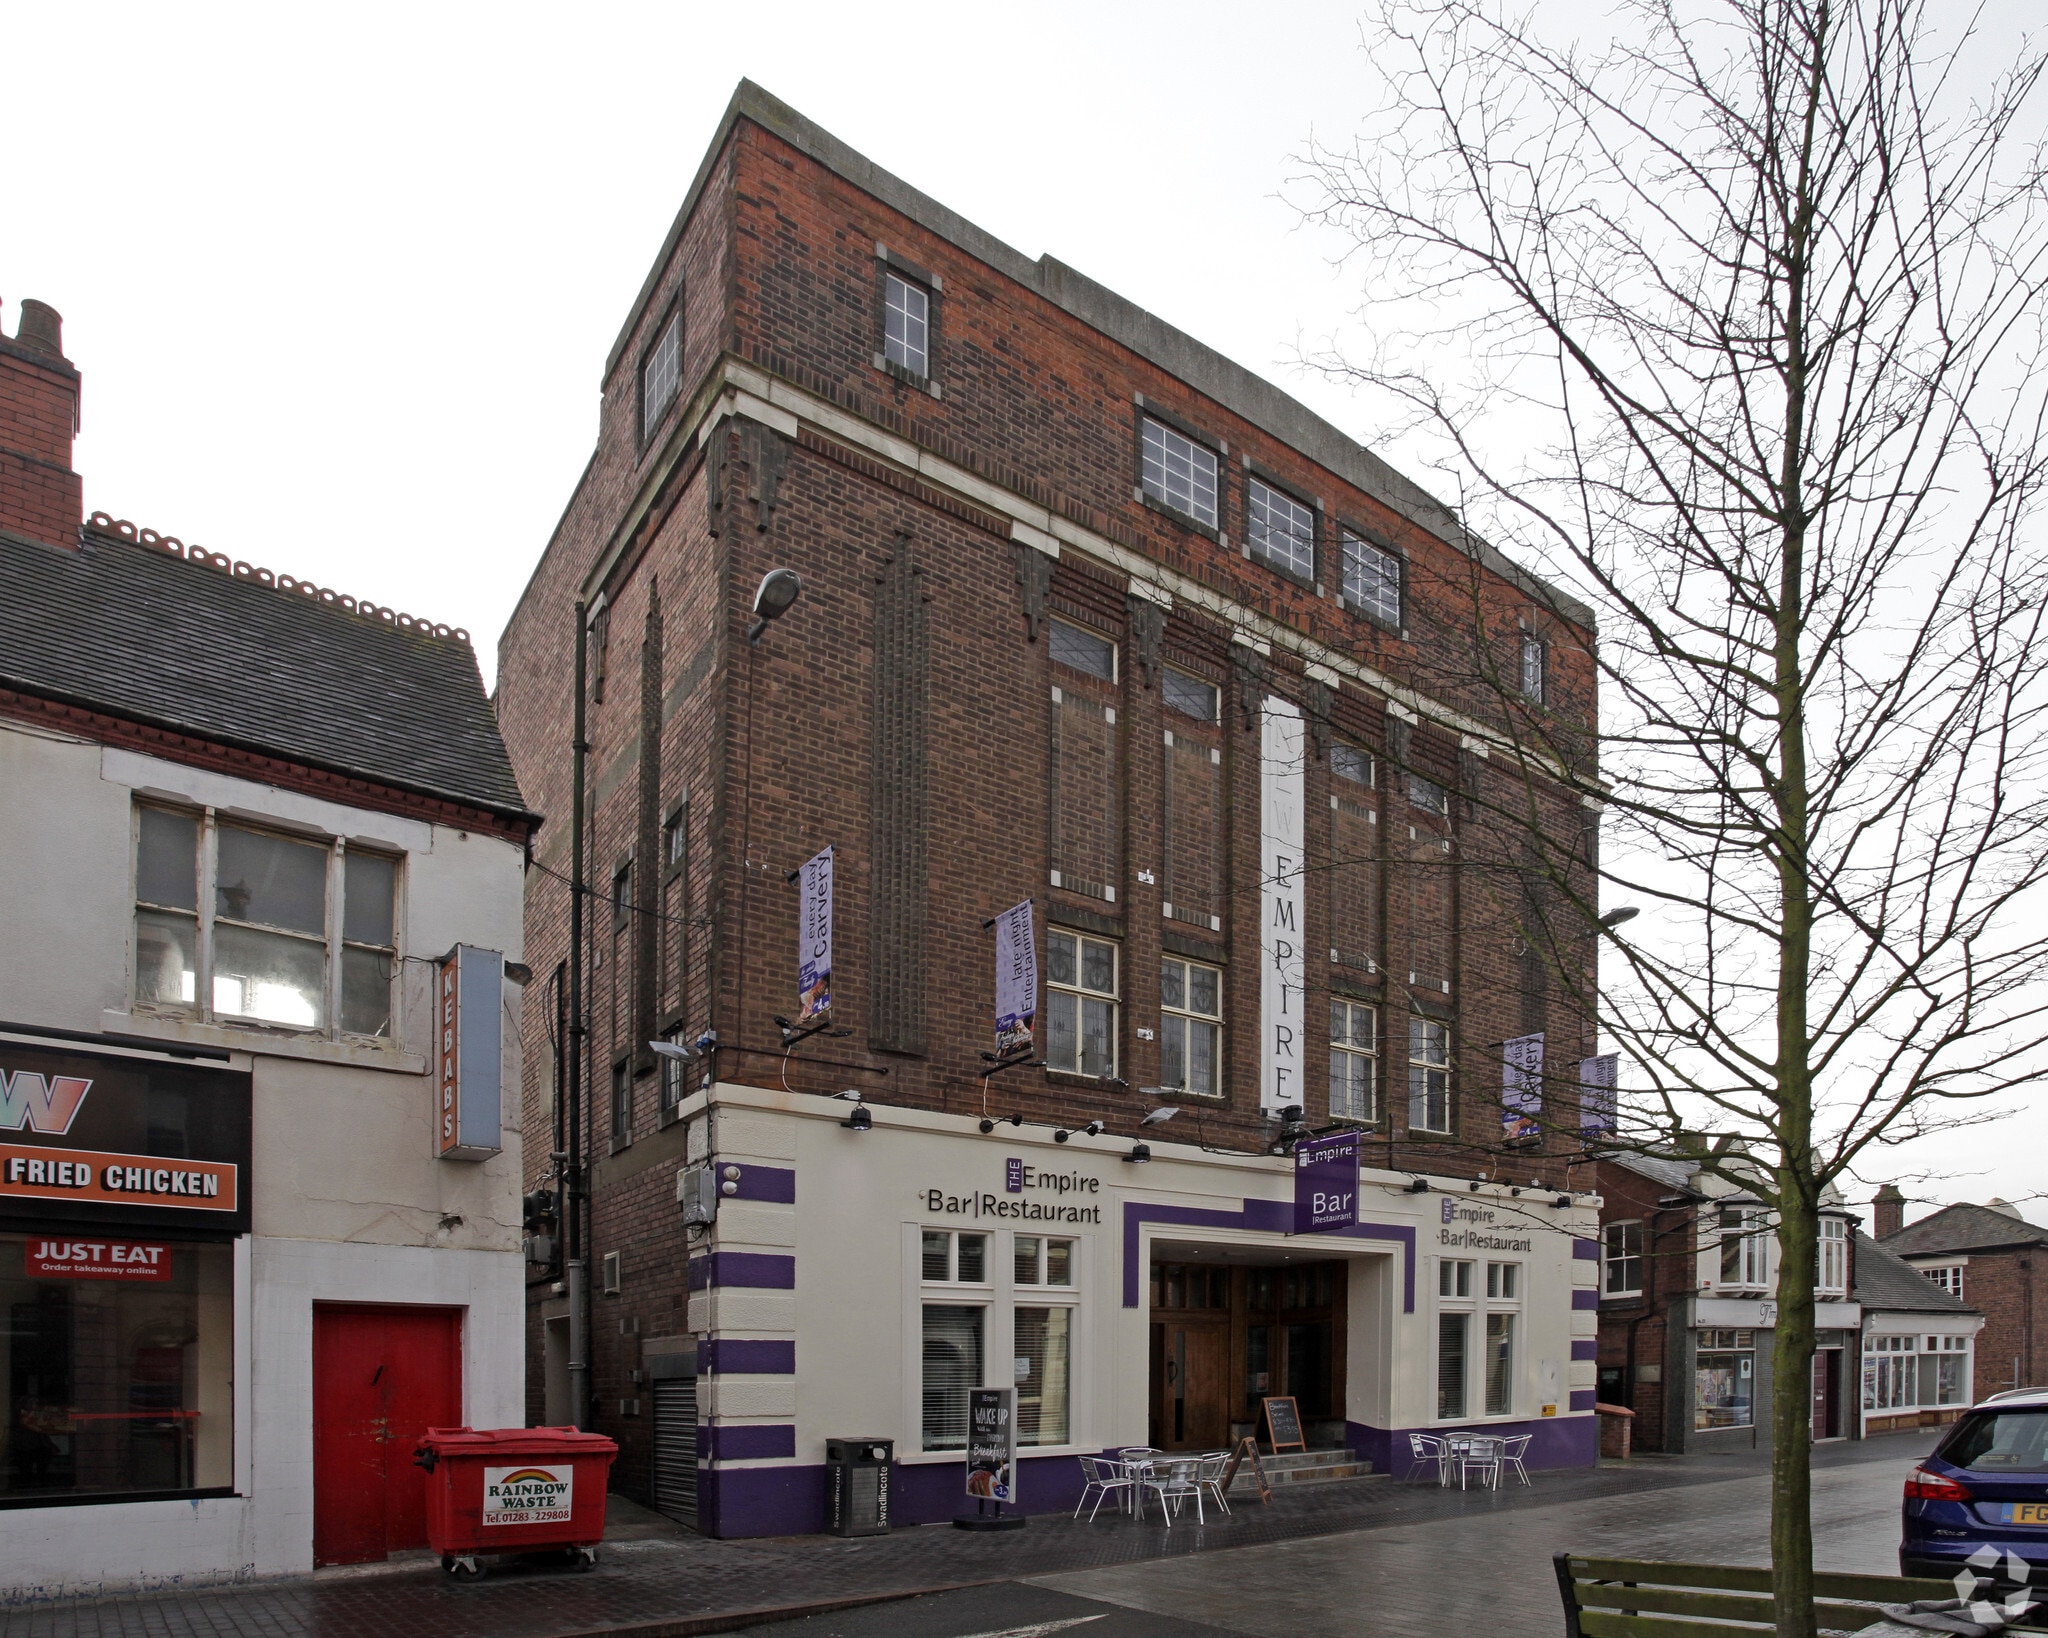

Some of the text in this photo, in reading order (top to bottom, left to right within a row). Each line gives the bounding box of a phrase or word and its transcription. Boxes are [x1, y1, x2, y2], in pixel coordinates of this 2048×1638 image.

[807, 863, 817, 939] every day
[814, 856, 830, 958] Carvery
[1010, 908, 1023, 981] late night
[1020, 903, 1033, 1012] Entertainment
[1274, 855, 1296, 1099] EMPIRE
[444, 970, 453, 1138] KEBABS
[1308, 1145, 1353, 1164] Empire
[9, 1157, 219, 1196] FRIED CHICKEN
[1009, 1161, 1100, 1194] THE Empire
[1313, 1192, 1352, 1214] Bar
[1443, 1200, 1495, 1224] THE Empire
[34, 1241, 164, 1264] JUST EAT
[41, 1263, 158, 1275] Order takeaway online
[975, 1407, 1009, 1425] WAKE UP
[974, 1443, 1008, 1462] Breakfast
[489, 1483, 569, 1497] RAINBOW
[878, 1466, 888, 1528] Swadlincote
[502, 1496, 556, 1509] WASTE
[486, 1514, 501, 1523] Tel.
